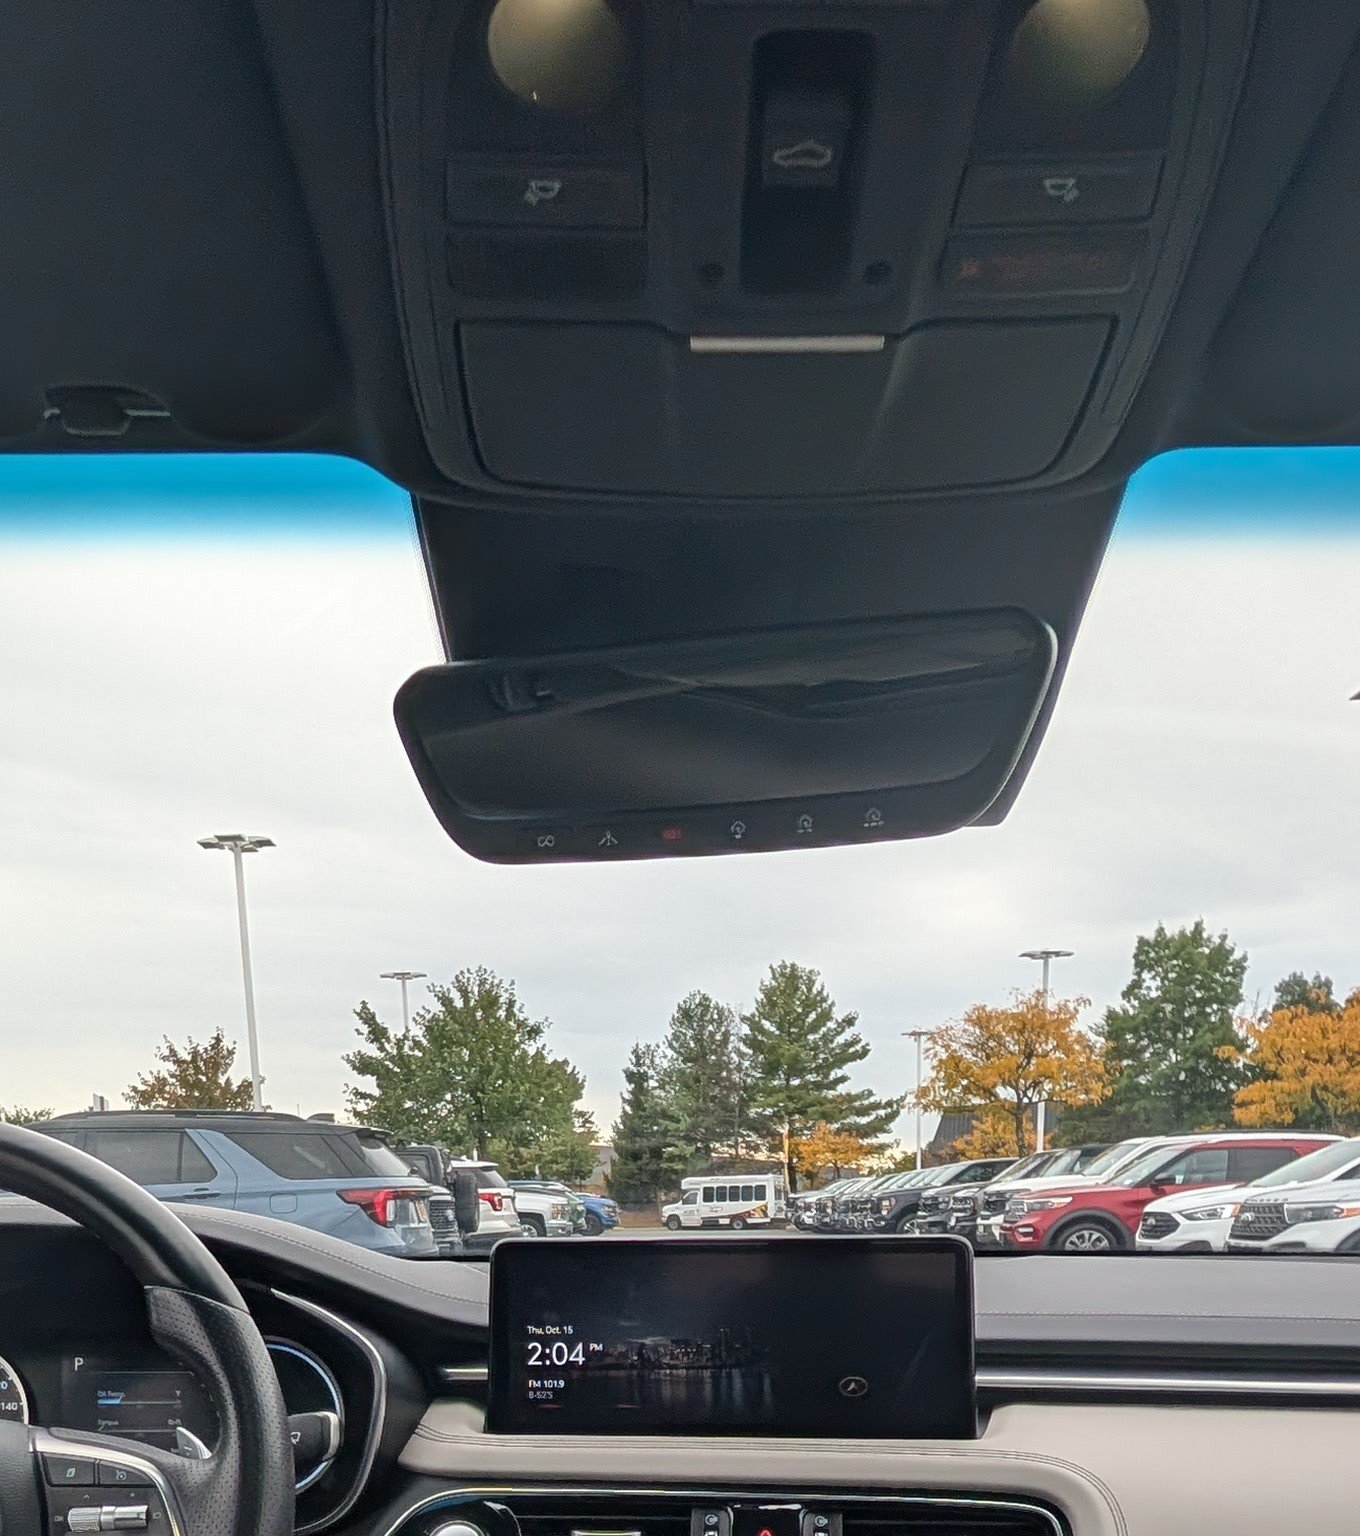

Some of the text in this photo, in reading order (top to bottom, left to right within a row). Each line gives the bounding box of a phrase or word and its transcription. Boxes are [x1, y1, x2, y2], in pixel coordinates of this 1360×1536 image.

[563, 1325, 574, 1335] 15
[527, 1342, 604, 1366] 2:04 PM
[74, 1357, 84, 1371] P
[0, 1401, 18, 1411] 140
